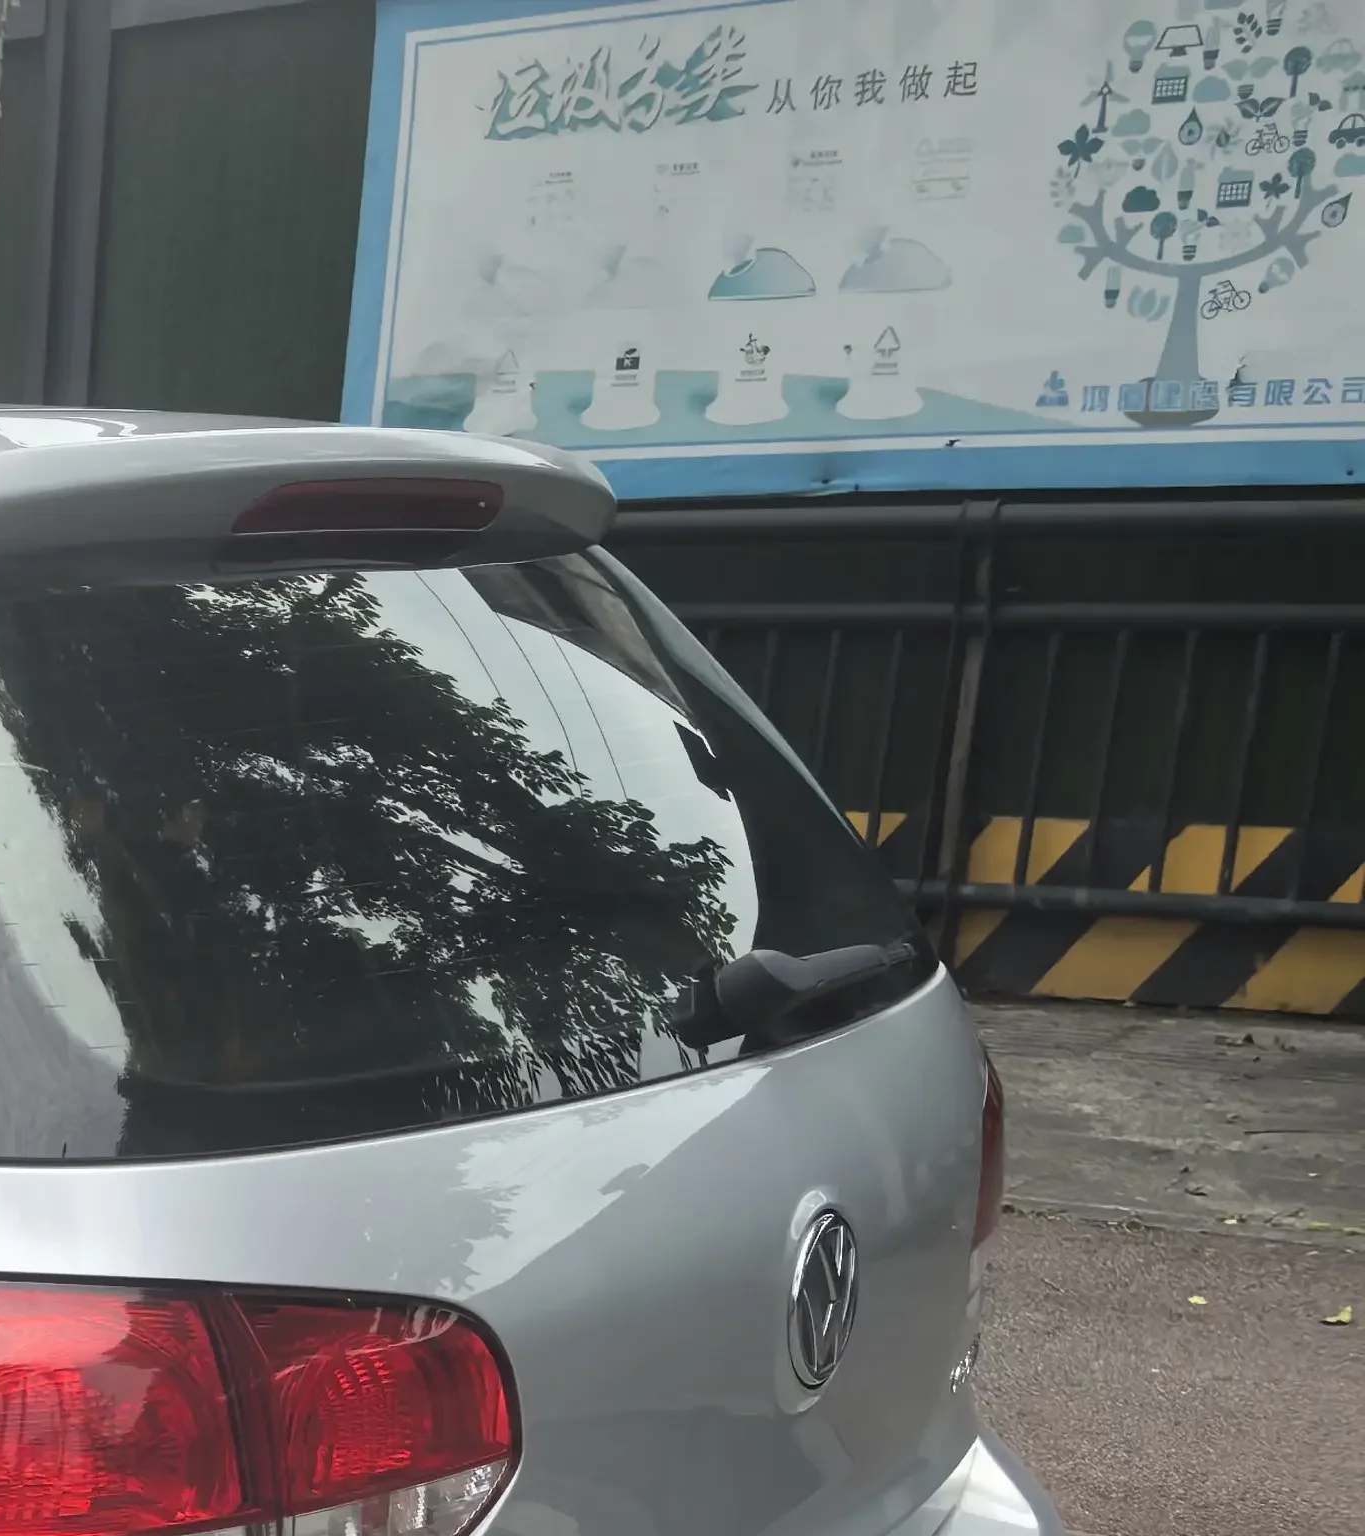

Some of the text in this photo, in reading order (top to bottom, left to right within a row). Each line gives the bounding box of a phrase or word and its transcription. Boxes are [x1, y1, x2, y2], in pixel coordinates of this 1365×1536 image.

[475, 24, 978, 140] 垃圾分类 从你我做起
